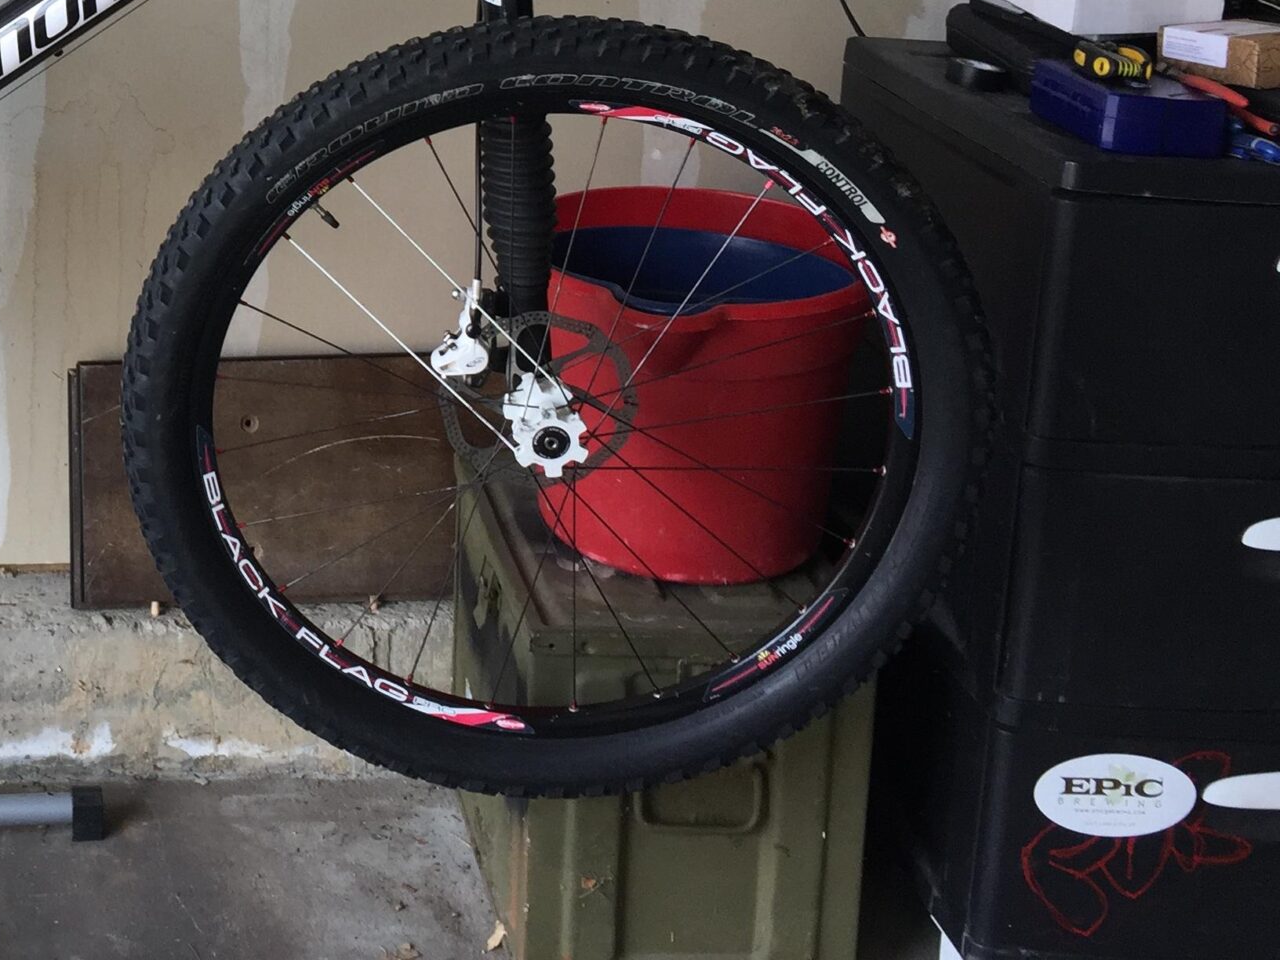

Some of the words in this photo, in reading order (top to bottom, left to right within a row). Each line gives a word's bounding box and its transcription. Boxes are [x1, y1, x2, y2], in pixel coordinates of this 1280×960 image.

[705, 130, 828, 217] FLAG
[816, 159, 868, 208] CONTROL
[833, 228, 914, 389] BLACK
[202, 469, 288, 619] BLACK
[294, 625, 410, 704] FLAG
[1057, 797, 1163, 809] BREWING
